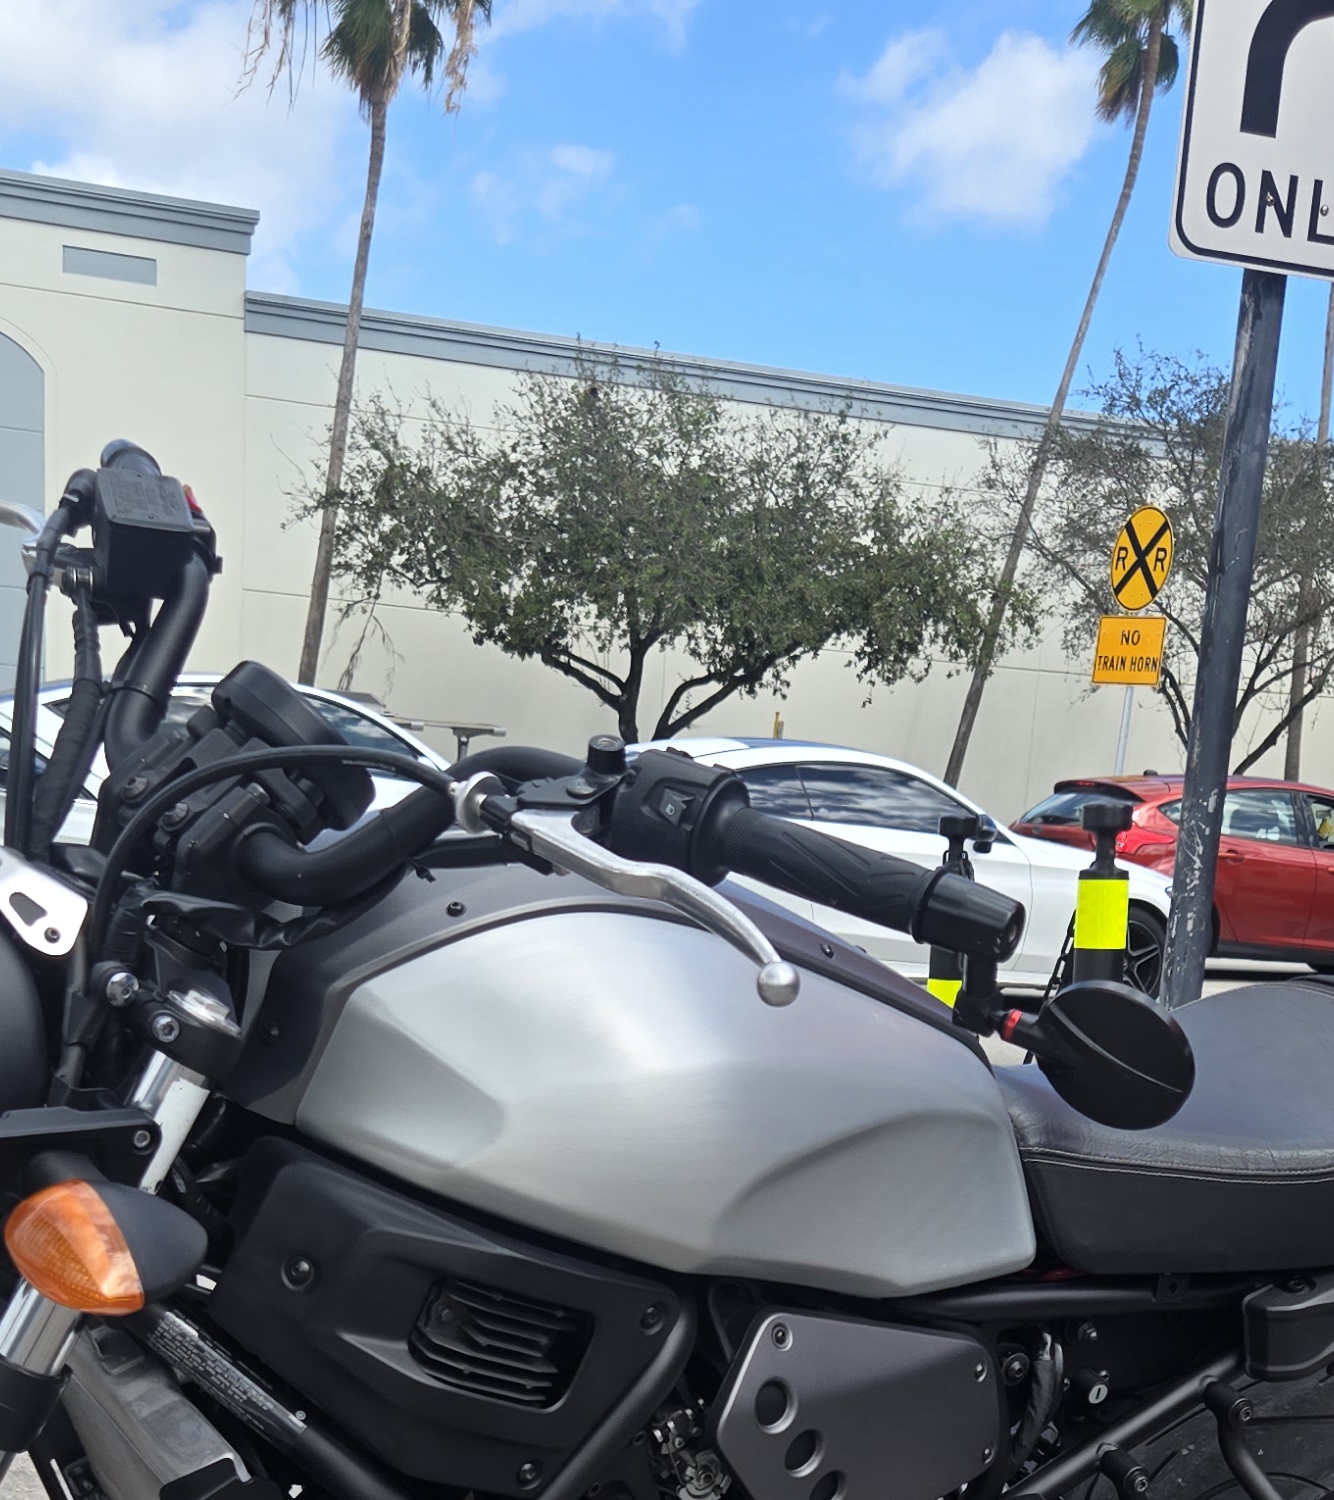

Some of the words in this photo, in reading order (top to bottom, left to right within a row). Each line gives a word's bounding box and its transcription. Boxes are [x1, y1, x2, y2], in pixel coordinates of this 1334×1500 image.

[1115, 546, 1129, 571] R
[1153, 547, 1167, 573] R
[1120, 629, 1141, 646] NO
[1097, 655, 1127, 672] TRAIN
[1129, 656, 1158, 673] HORN
